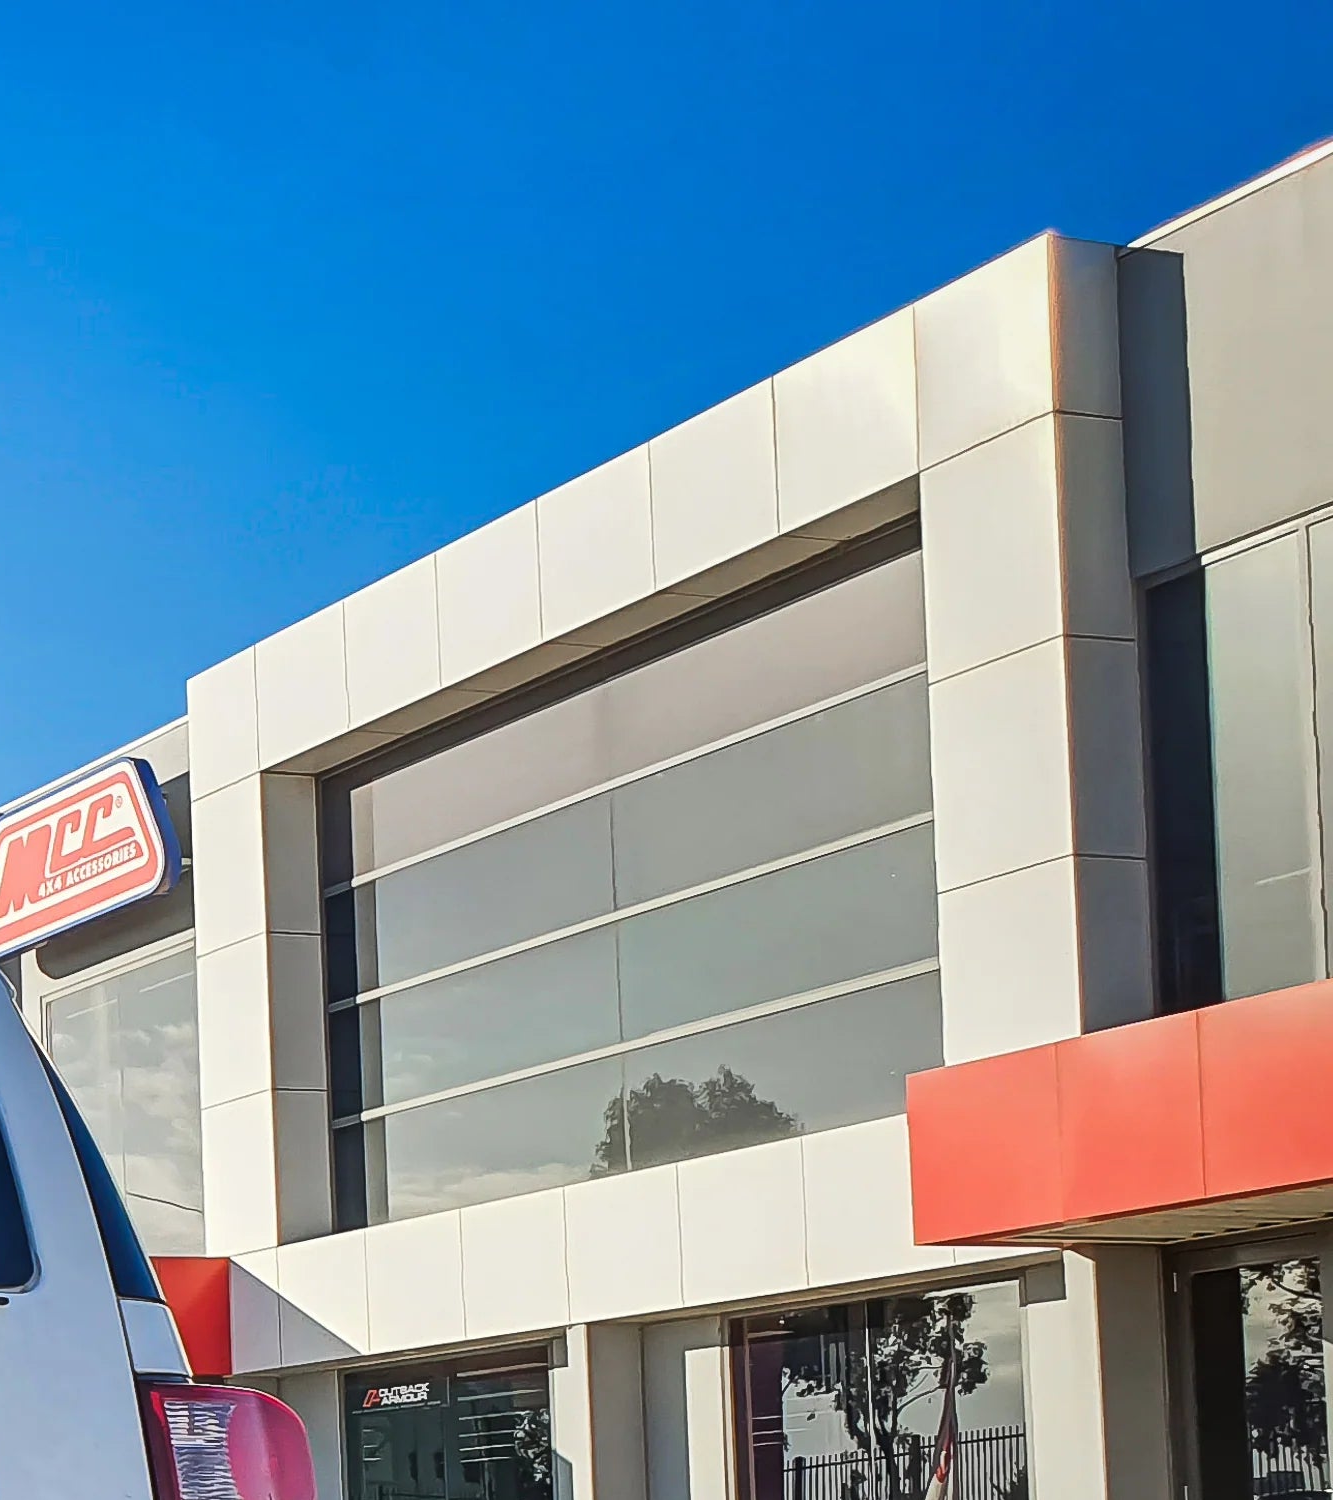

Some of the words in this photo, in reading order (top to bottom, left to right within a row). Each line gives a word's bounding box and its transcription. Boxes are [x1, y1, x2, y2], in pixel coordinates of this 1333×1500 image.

[66, 842, 137, 887] ACCESSORIES
[378, 1382, 429, 1397] OUTBACK
[380, 1391, 428, 1406] ARMOUR
